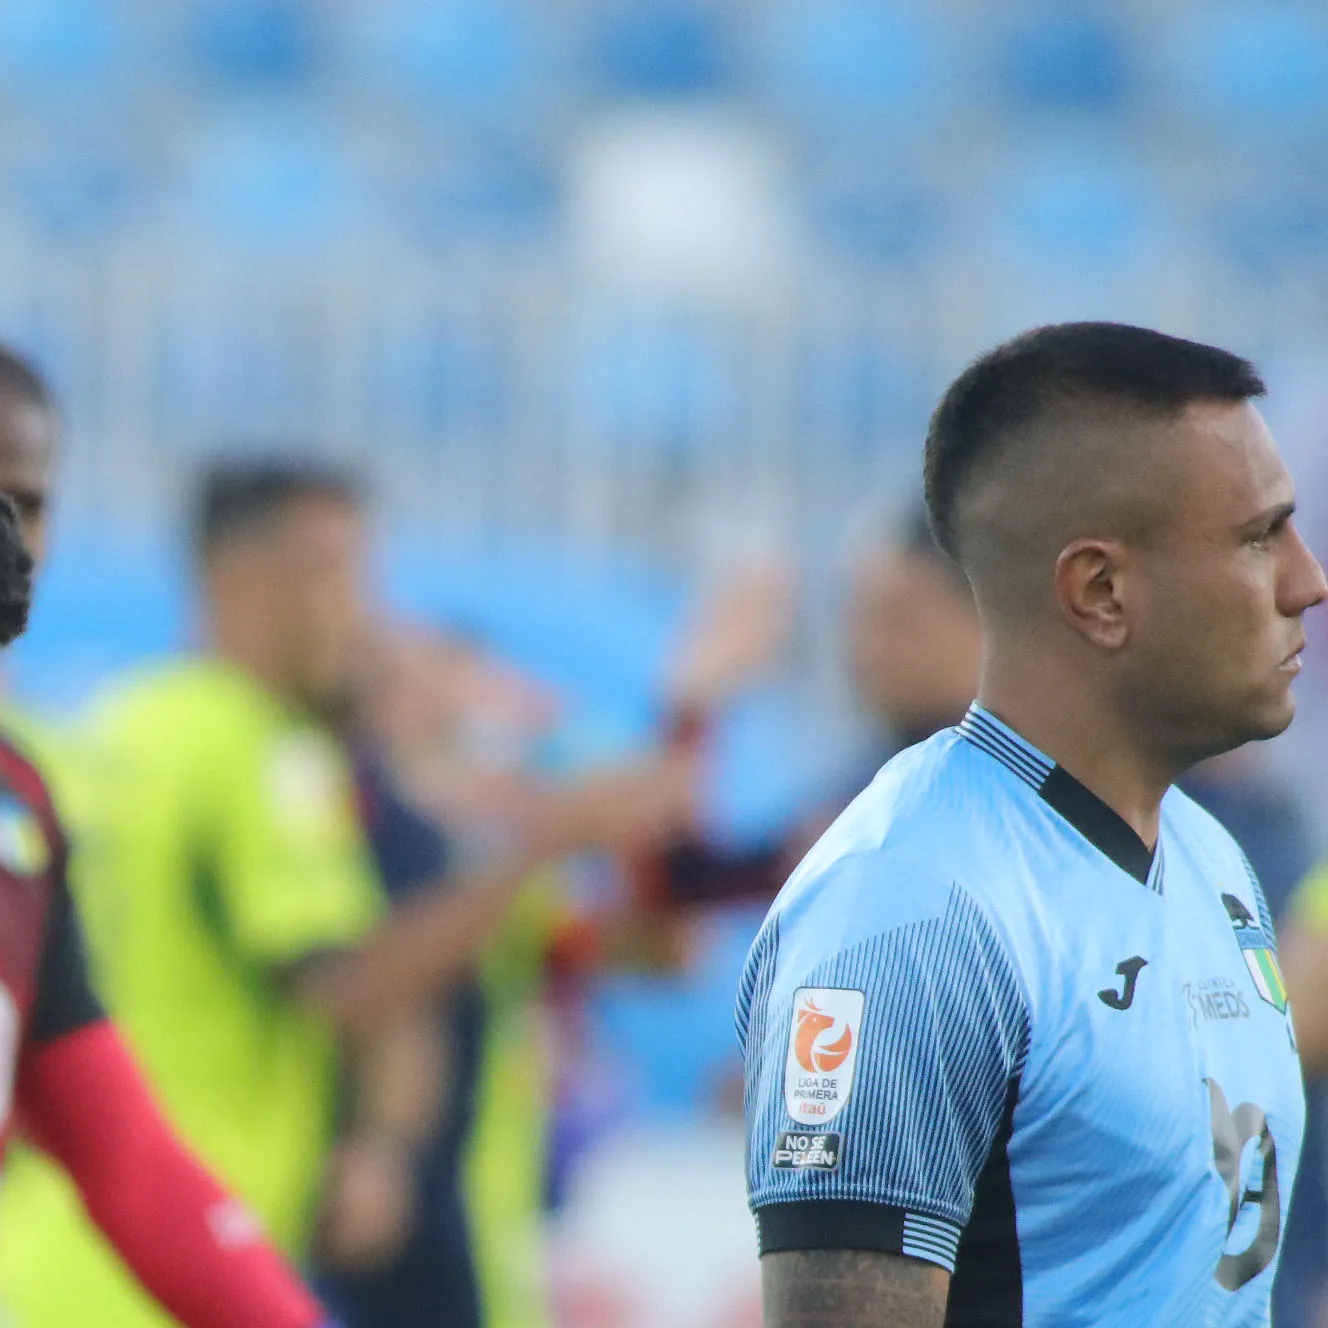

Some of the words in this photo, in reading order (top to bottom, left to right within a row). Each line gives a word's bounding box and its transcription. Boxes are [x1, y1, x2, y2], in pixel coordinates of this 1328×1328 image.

[798, 1078, 819, 1088] LIGA
[821, 1079, 837, 1089] DE
[793, 1090, 838, 1101] PRIMERA
[785, 1136, 808, 1150] NO
